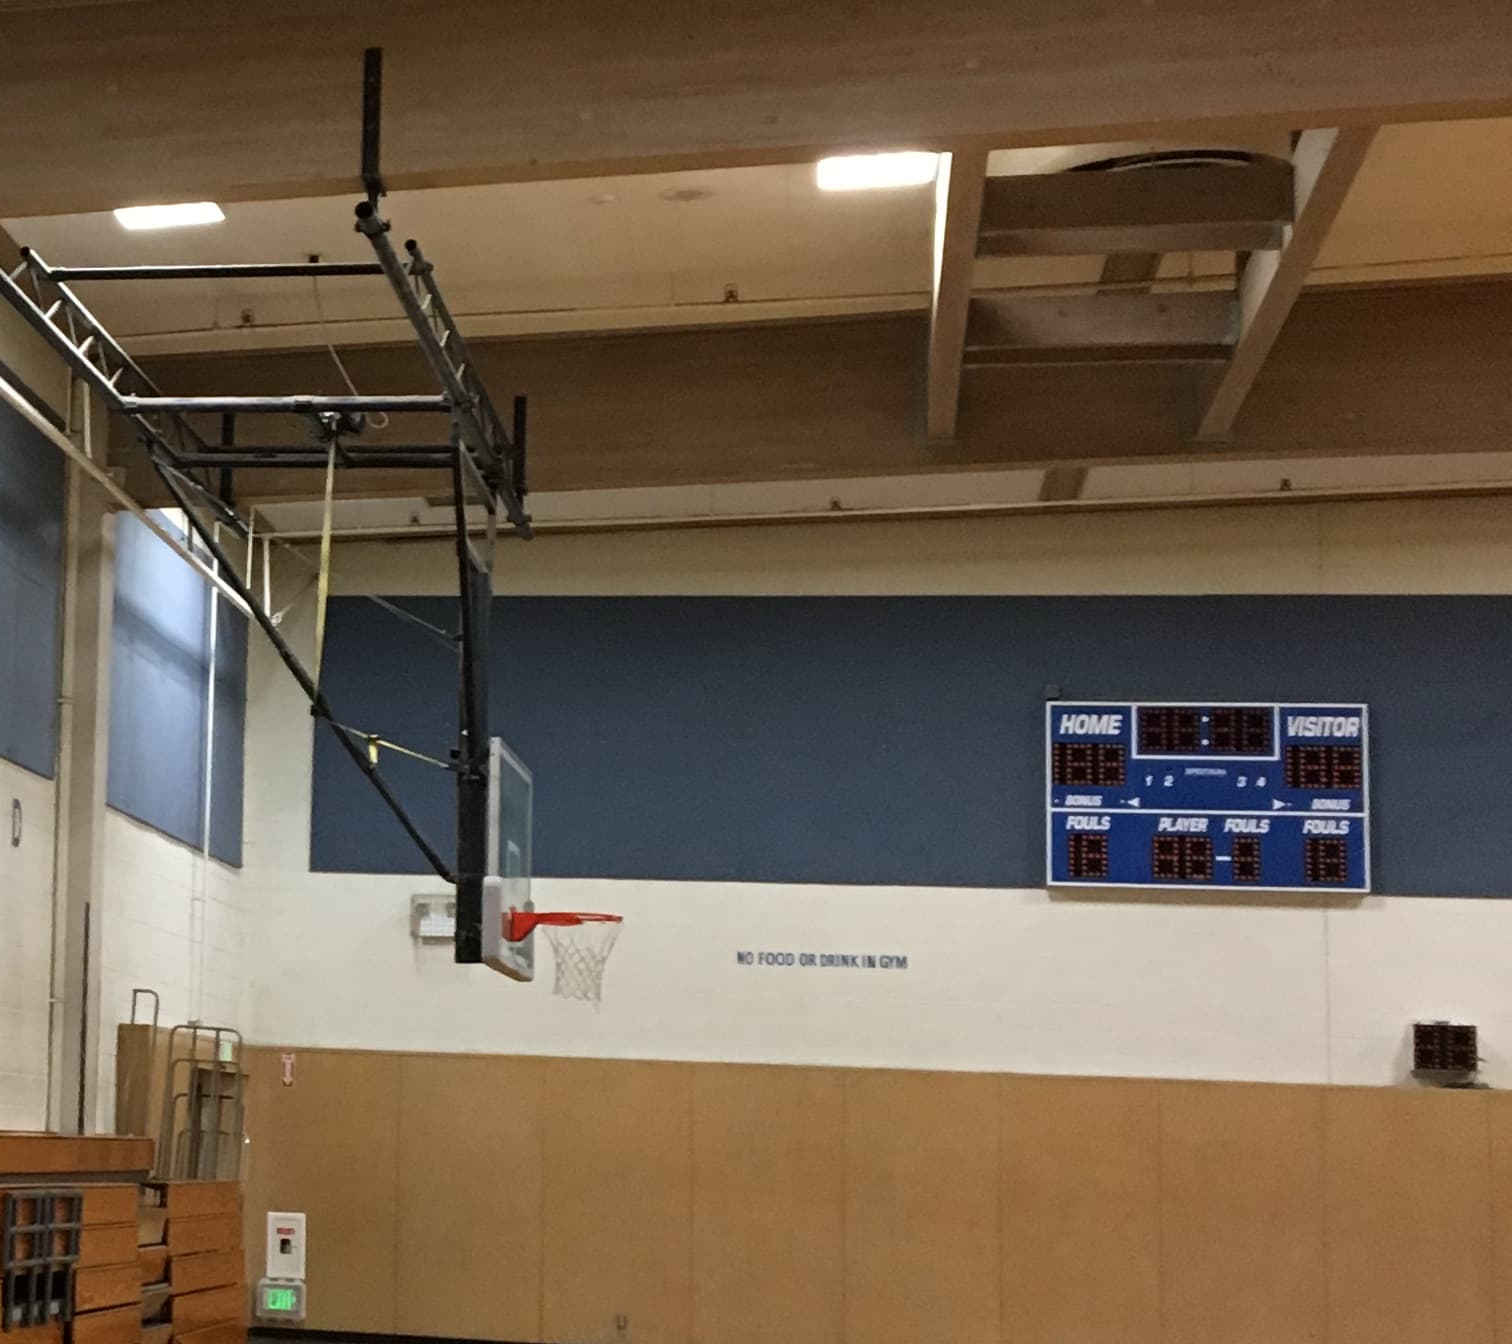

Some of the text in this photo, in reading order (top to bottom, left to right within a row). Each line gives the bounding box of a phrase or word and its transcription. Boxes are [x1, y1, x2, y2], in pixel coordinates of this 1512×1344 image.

[1059, 714, 1123, 735] HOME
[1287, 715, 1361, 737] VISITOR
[1163, 775, 1174, 787] 2
[1236, 776, 1248, 788] 3
[1255, 776, 1267, 788] 4
[1065, 815, 1112, 831] FOULS
[1158, 817, 1271, 834] PLAYER FOULS
[1302, 819, 1350, 835] FOULS
[736, 951, 908, 970] NO FOOD OR DRINK IN GYM
